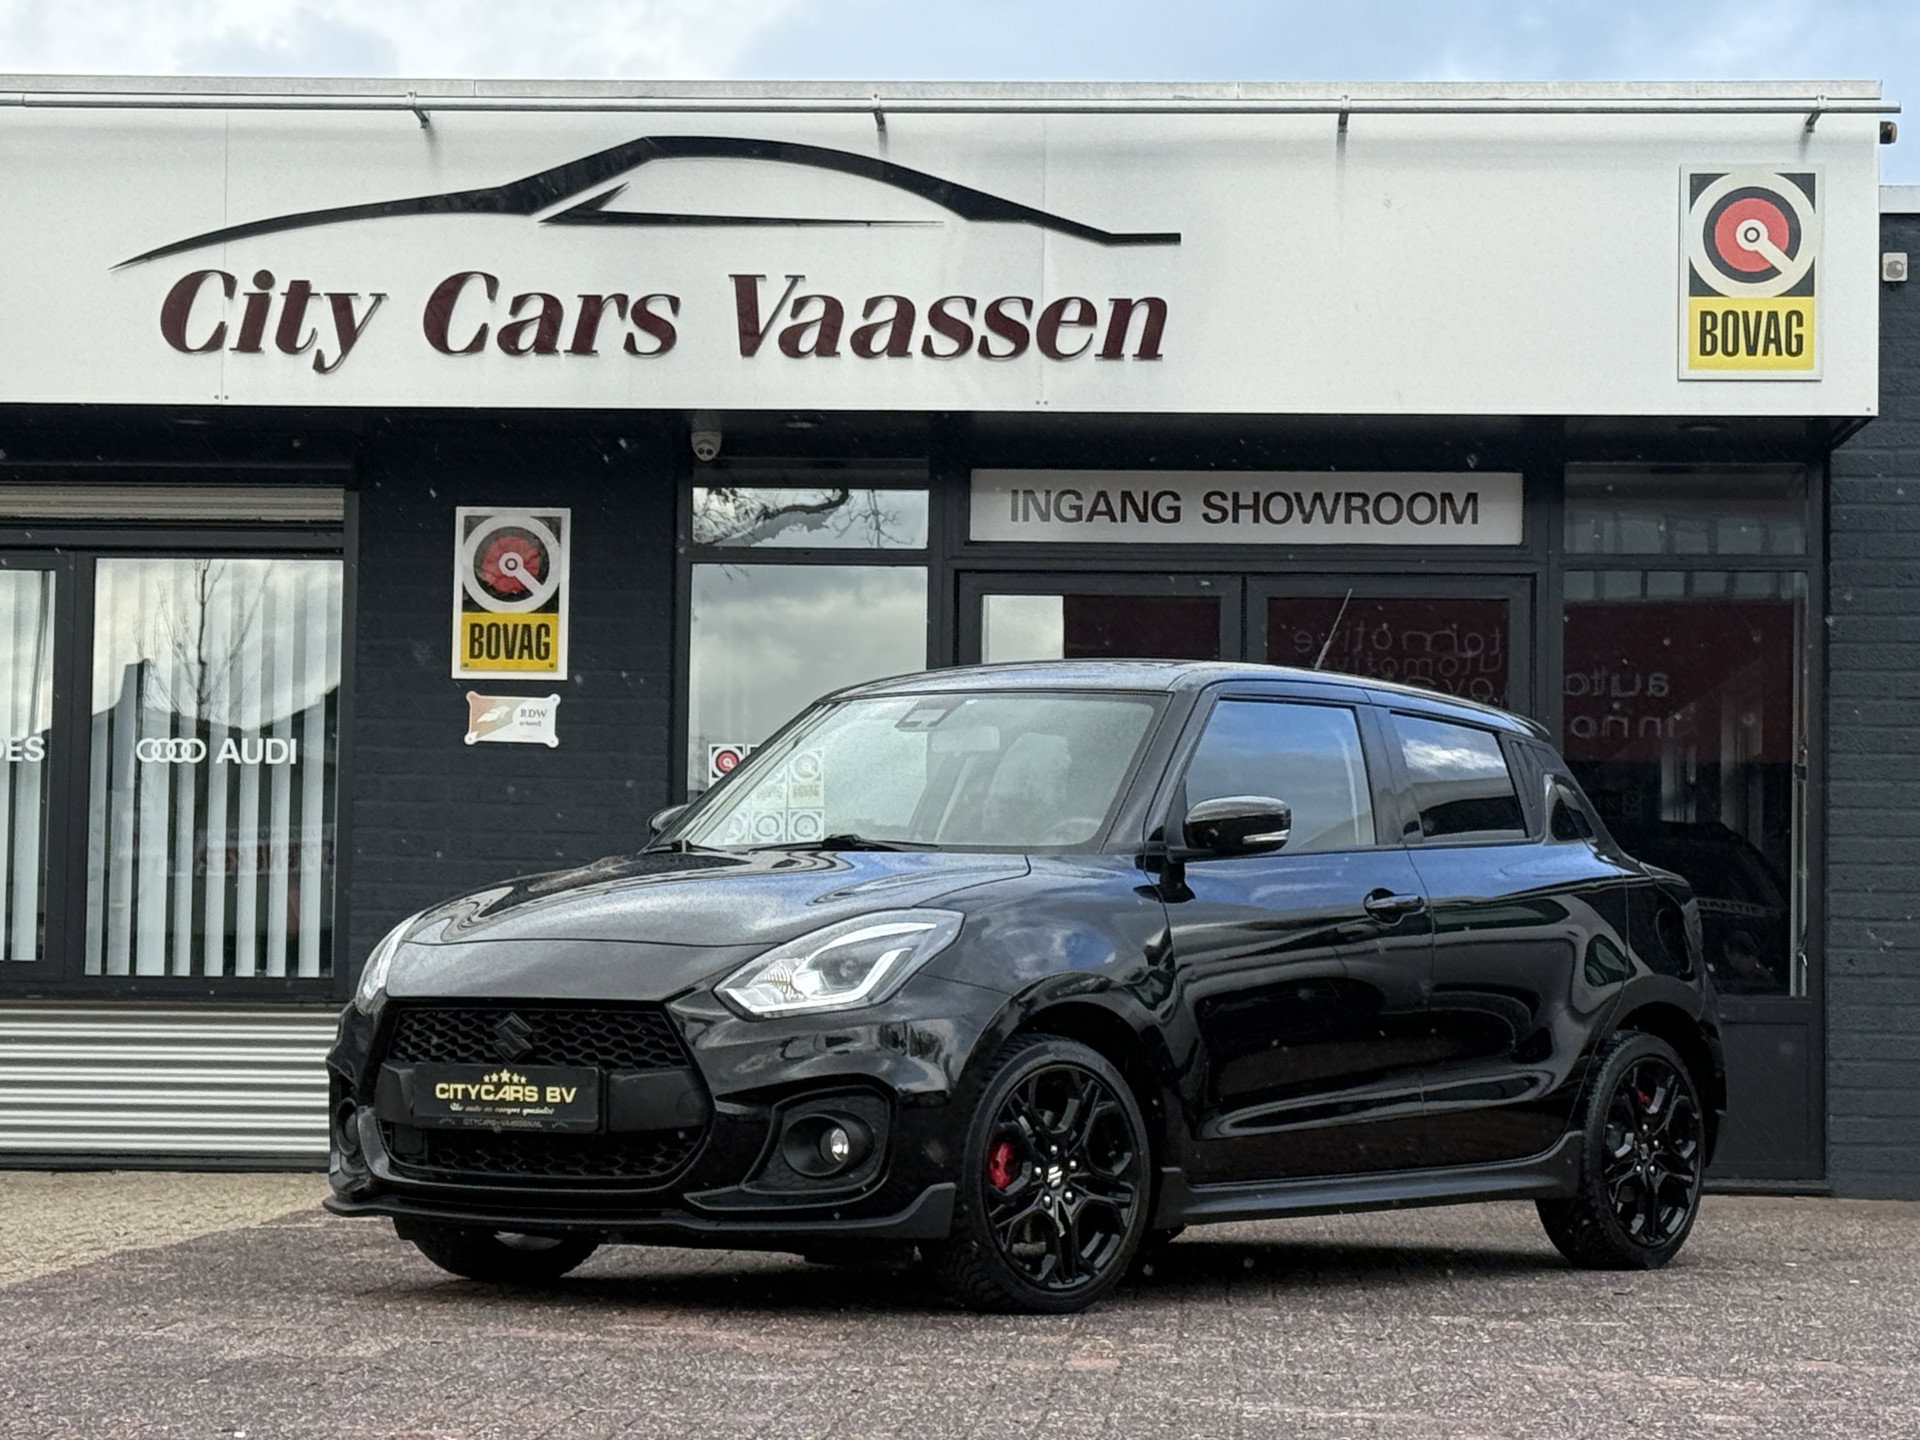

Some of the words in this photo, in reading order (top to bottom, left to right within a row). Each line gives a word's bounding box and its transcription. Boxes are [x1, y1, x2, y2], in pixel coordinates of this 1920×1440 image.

[160, 269, 388, 374] City
[422, 271, 680, 356] Cars
[728, 273, 1168, 360] Vaassen
[1700, 310, 1804, 357] BOVAG
[1010, 489, 1182, 523] INGANG
[1201, 491, 1479, 525] SHOWROOM
[469, 622, 550, 661] BOVAG
[520, 709, 548, 718] RDW
[0, 736, 45, 762] ES
[216, 738, 297, 764] AUDI
[435, 1083, 539, 1102] CITYCARS
[545, 1086, 577, 1103] BV
